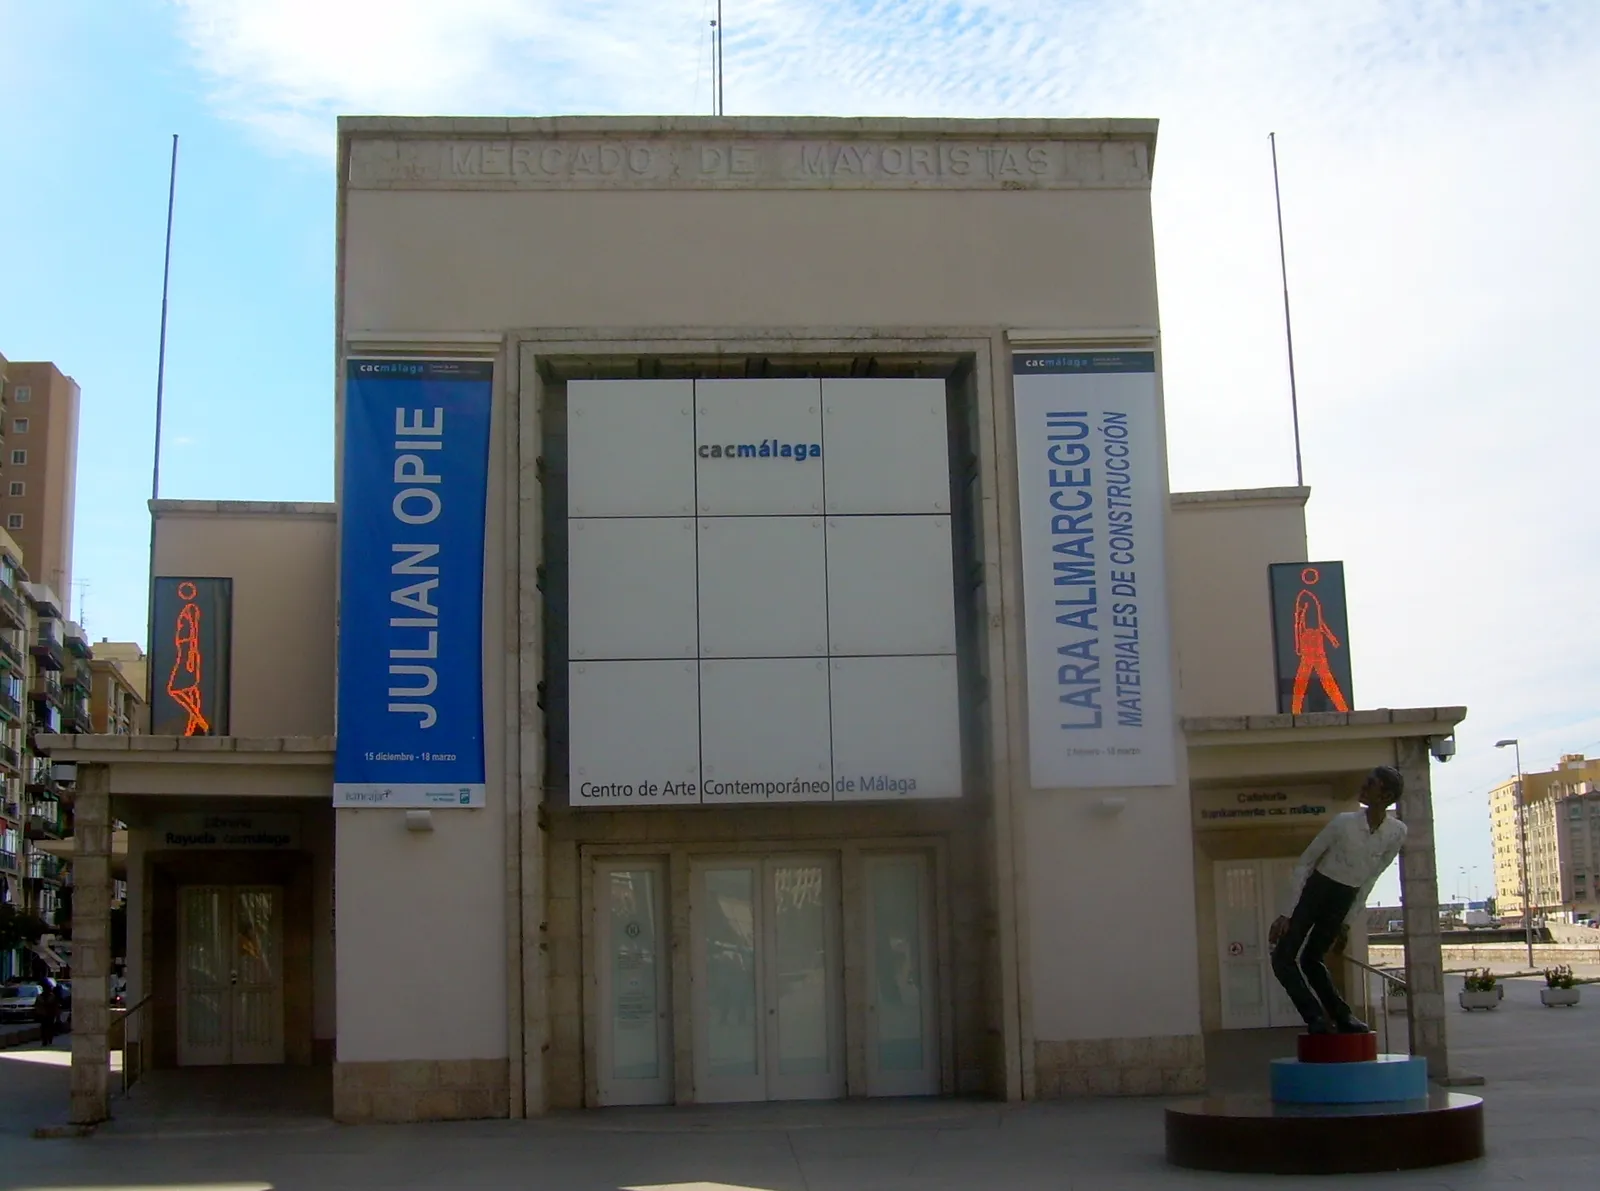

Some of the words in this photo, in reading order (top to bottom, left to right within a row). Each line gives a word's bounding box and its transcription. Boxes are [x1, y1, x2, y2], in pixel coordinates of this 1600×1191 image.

[449, 143, 653, 177] MERCADO
[699, 145, 758, 176] DE
[799, 143, 1051, 177] MAYORISTAS
[392, 406, 444, 525] OPIE
[698, 439, 821, 462] cacmálaga
[1097, 411, 1136, 565] CONSTRUCCIÓN
[1045, 411, 1099, 632] ALMARCEGUI
[1110, 570, 1137, 598] DE
[387, 543, 440, 729] JULIAN
[1111, 602, 1143, 728] MATERIALES
[1056, 637, 1103, 730] LARA
[364, 752, 374, 761] 15
[375, 752, 415, 762] diciembre
[421, 752, 431, 761] 18
[432, 753, 457, 761] marzo
[580, 781, 633, 798] Centro
[638, 780, 658, 796] de
[662, 780, 696, 796] Arte
[703, 776, 830, 799] Contemporáneo
[835, 775, 855, 793] de
[860, 775, 917, 795] Málaga
[165, 831, 217, 847] Rayuela
